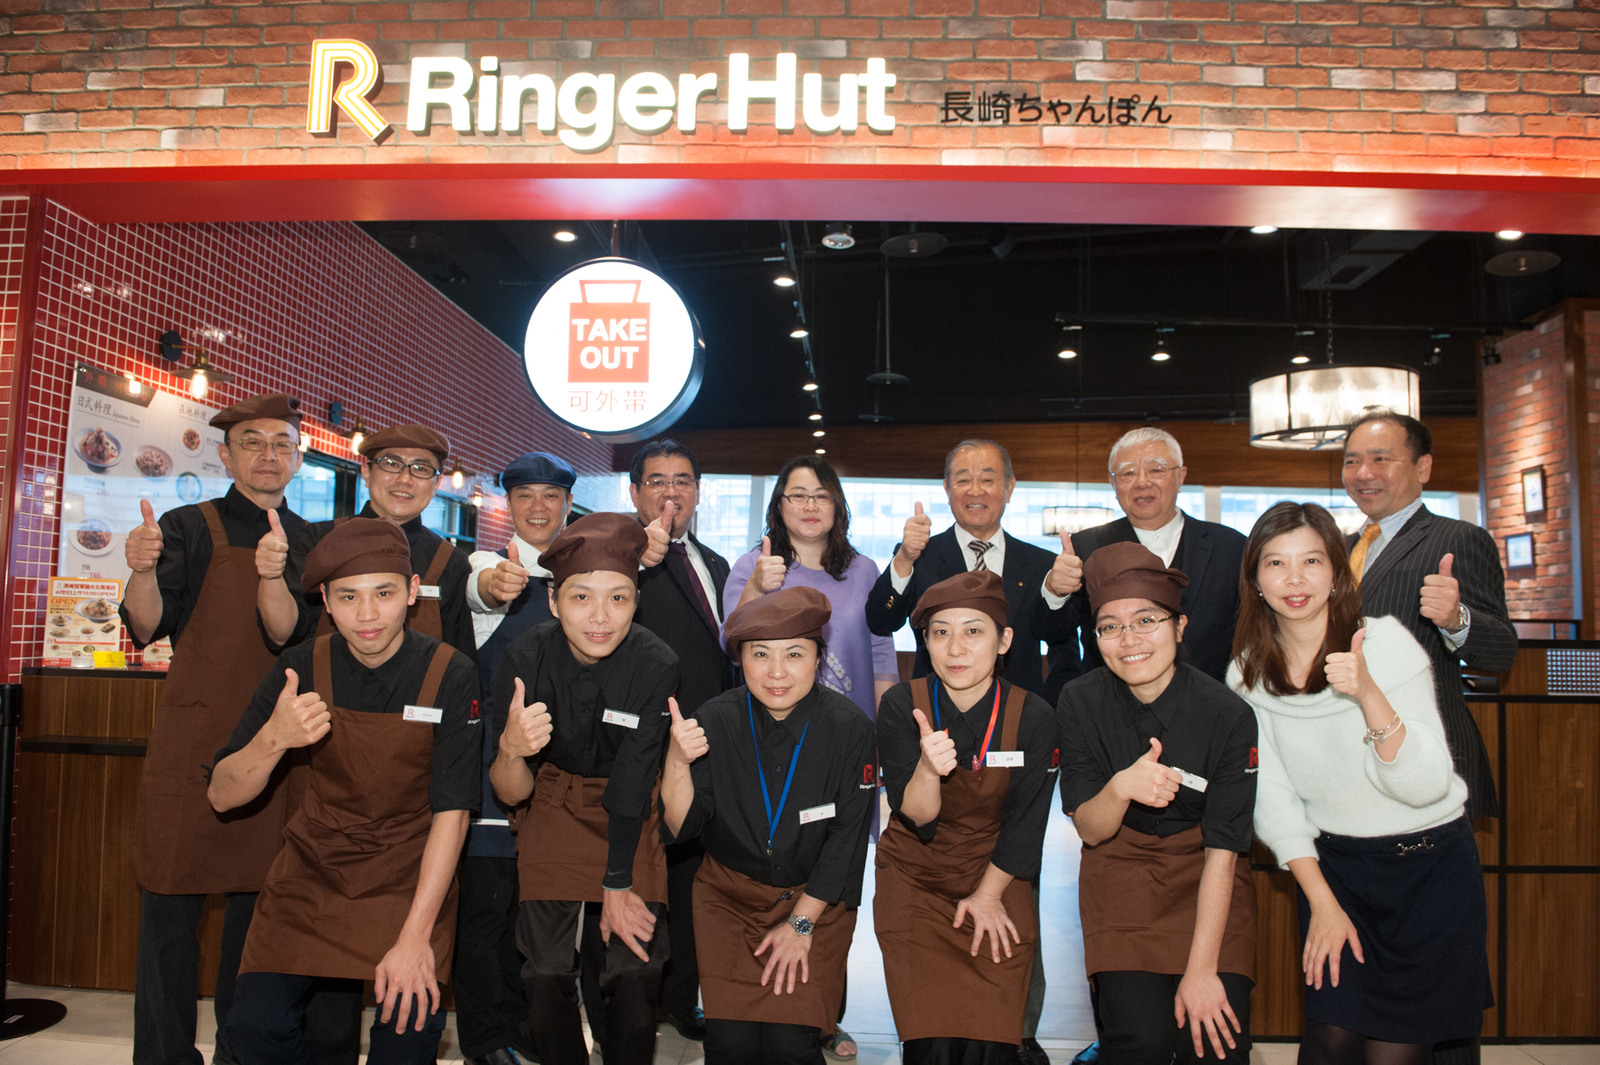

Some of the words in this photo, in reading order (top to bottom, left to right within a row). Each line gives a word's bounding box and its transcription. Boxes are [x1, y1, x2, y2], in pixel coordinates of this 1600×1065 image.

[406, 55, 718, 151] Ringer
[727, 52, 897, 133] Hut
[940, 91, 1173, 124] 長崎ちゃんぽん
[571, 318, 648, 342] TAKE
[579, 345, 640, 370] OUT
